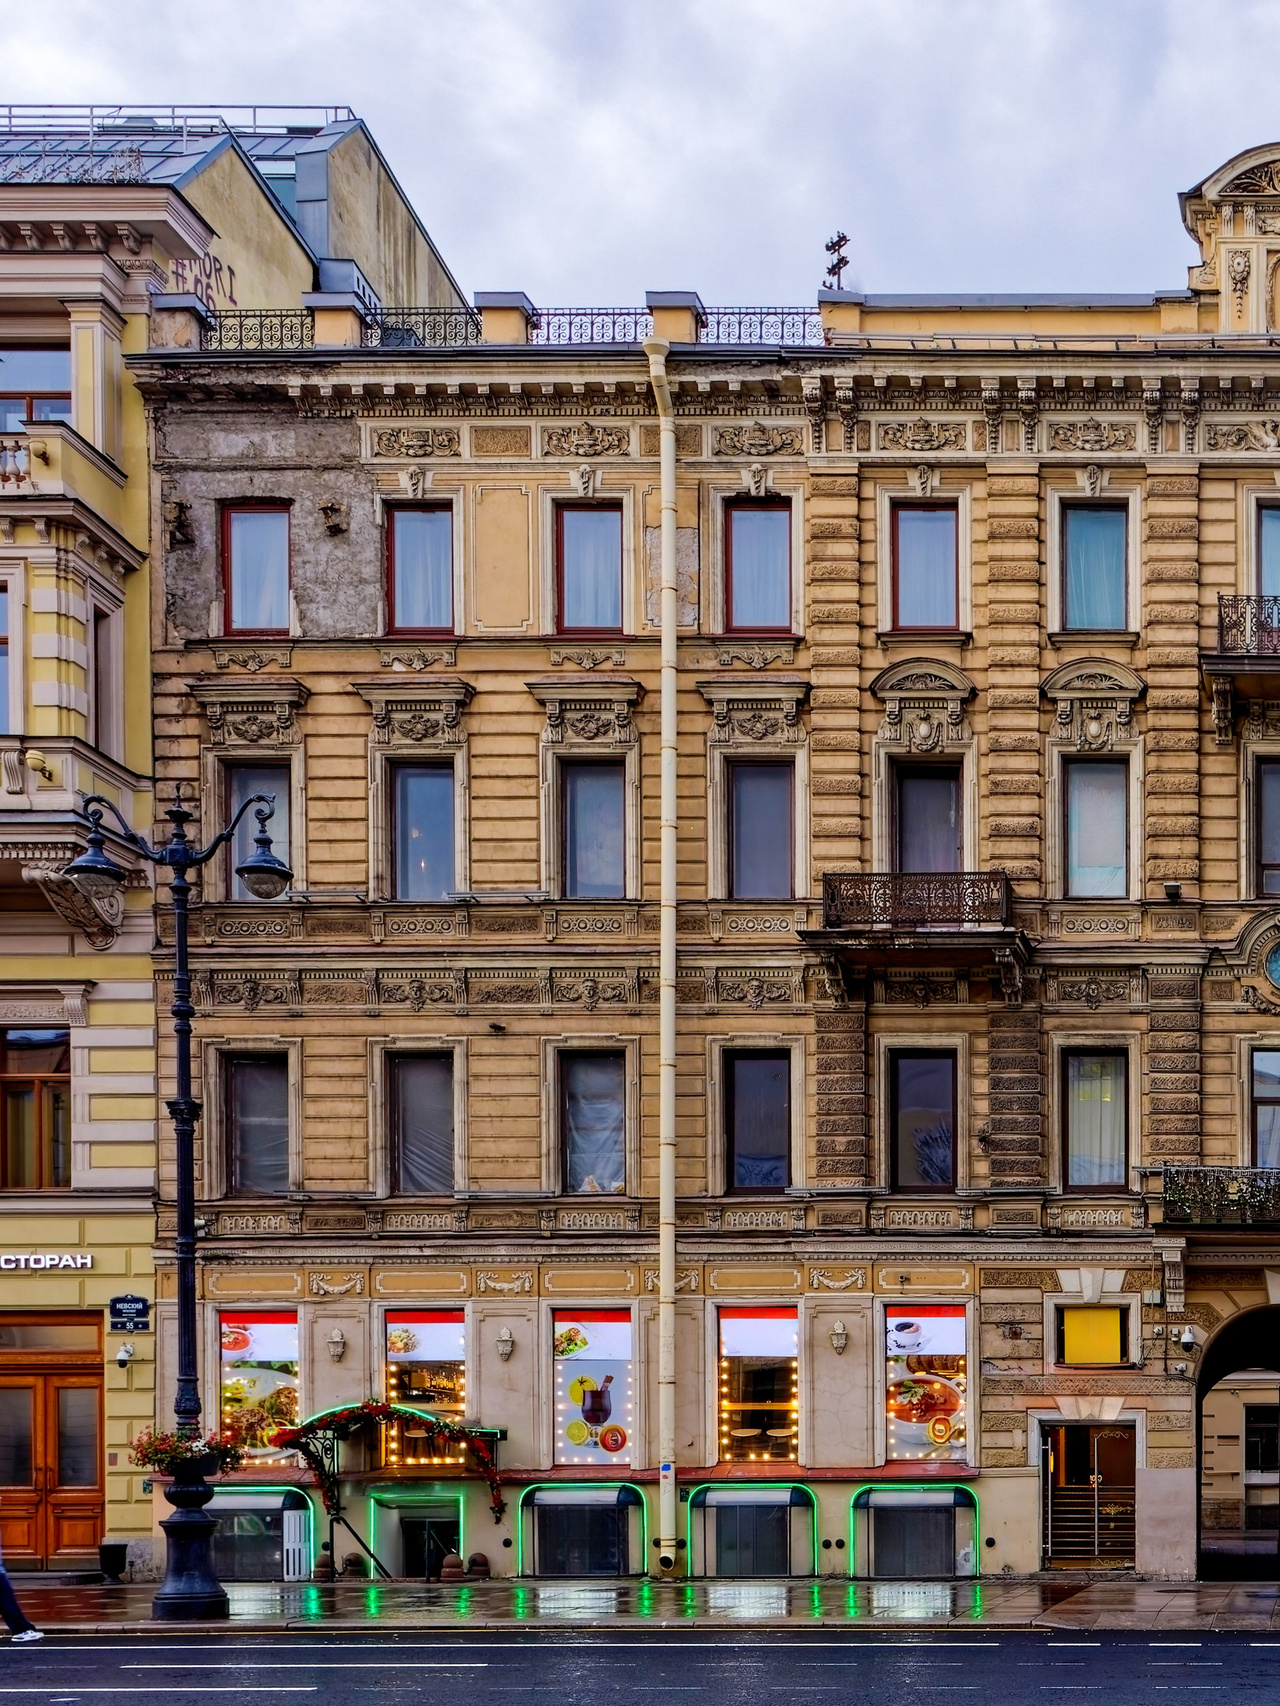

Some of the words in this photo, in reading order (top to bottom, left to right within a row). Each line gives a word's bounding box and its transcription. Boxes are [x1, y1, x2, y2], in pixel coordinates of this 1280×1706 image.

[0, 1254, 93, 1269] СТОРАН
[116, 1302, 143, 1310] НЕВСКИЙ
[125, 1322, 135, 1330] 55
